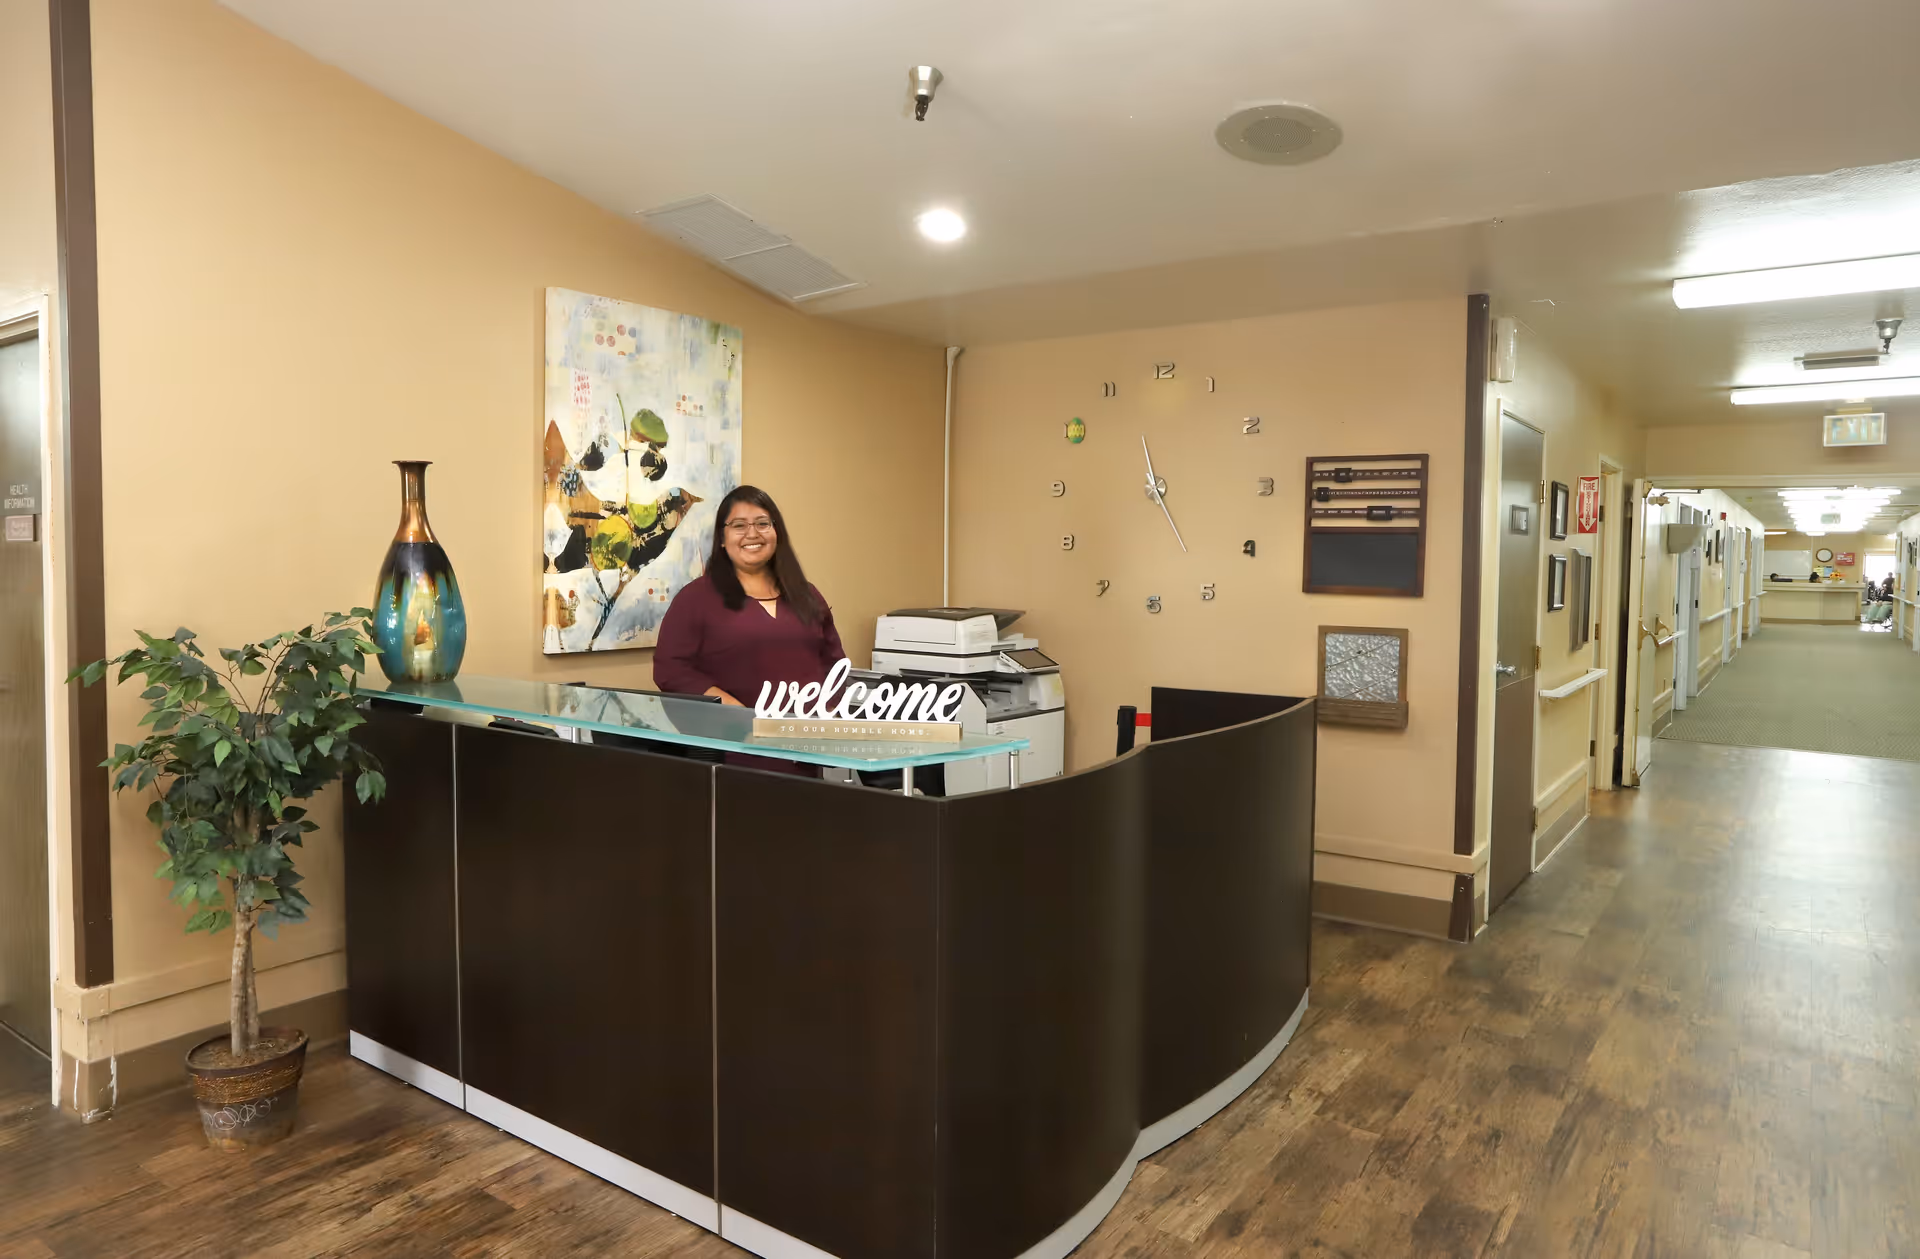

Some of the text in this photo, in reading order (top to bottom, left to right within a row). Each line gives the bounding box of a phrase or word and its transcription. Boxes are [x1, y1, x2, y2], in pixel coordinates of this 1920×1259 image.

[1153, 362, 1175, 380] 12
[1102, 381, 1116, 397] 11
[1206, 376, 1215, 392] 1
[1243, 416, 1260, 434] 2
[1050, 480, 1066, 497] 9
[1257, 477, 1274, 496] 3
[1583, 482, 1596, 491] FIRE
[1061, 535, 1075, 550] 8
[1242, 540, 1256, 557] 4
[1096, 580, 1110, 597] 7
[1201, 583, 1216, 600] 5
[1147, 596, 1162, 614] 6
[754, 657, 963, 721] welcome
[803, 725, 826, 733] OUR
[834, 726, 883, 734] HUMBLE
